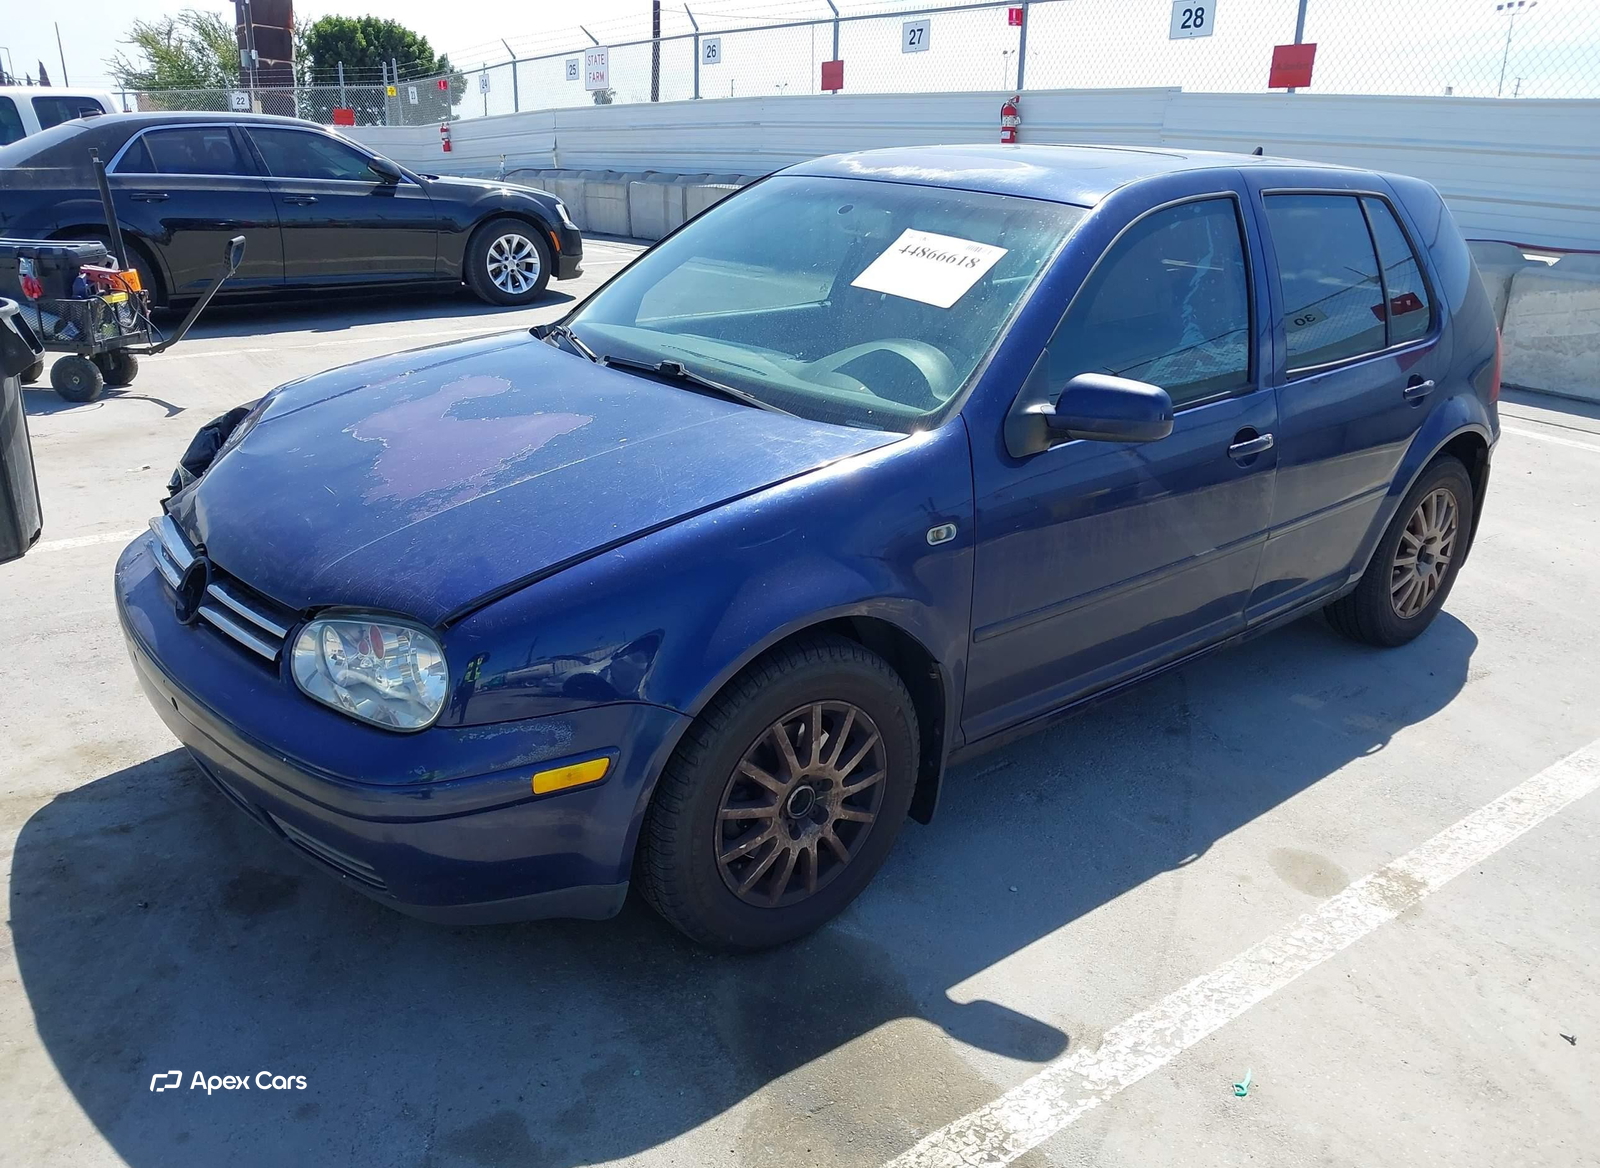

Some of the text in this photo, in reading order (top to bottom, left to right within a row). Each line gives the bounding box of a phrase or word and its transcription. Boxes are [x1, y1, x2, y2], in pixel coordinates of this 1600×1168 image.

[1180, 6, 1205, 30] 28
[908, 28, 924, 45] 27
[706, 44, 717, 59] 26
[587, 54, 605, 66] STATE
[568, 64, 577, 76] 25
[589, 70, 605, 83] FARM
[481, 79, 488, 89] 24
[236, 96, 246, 105] 22
[898, 244, 981, 269] 44866618
